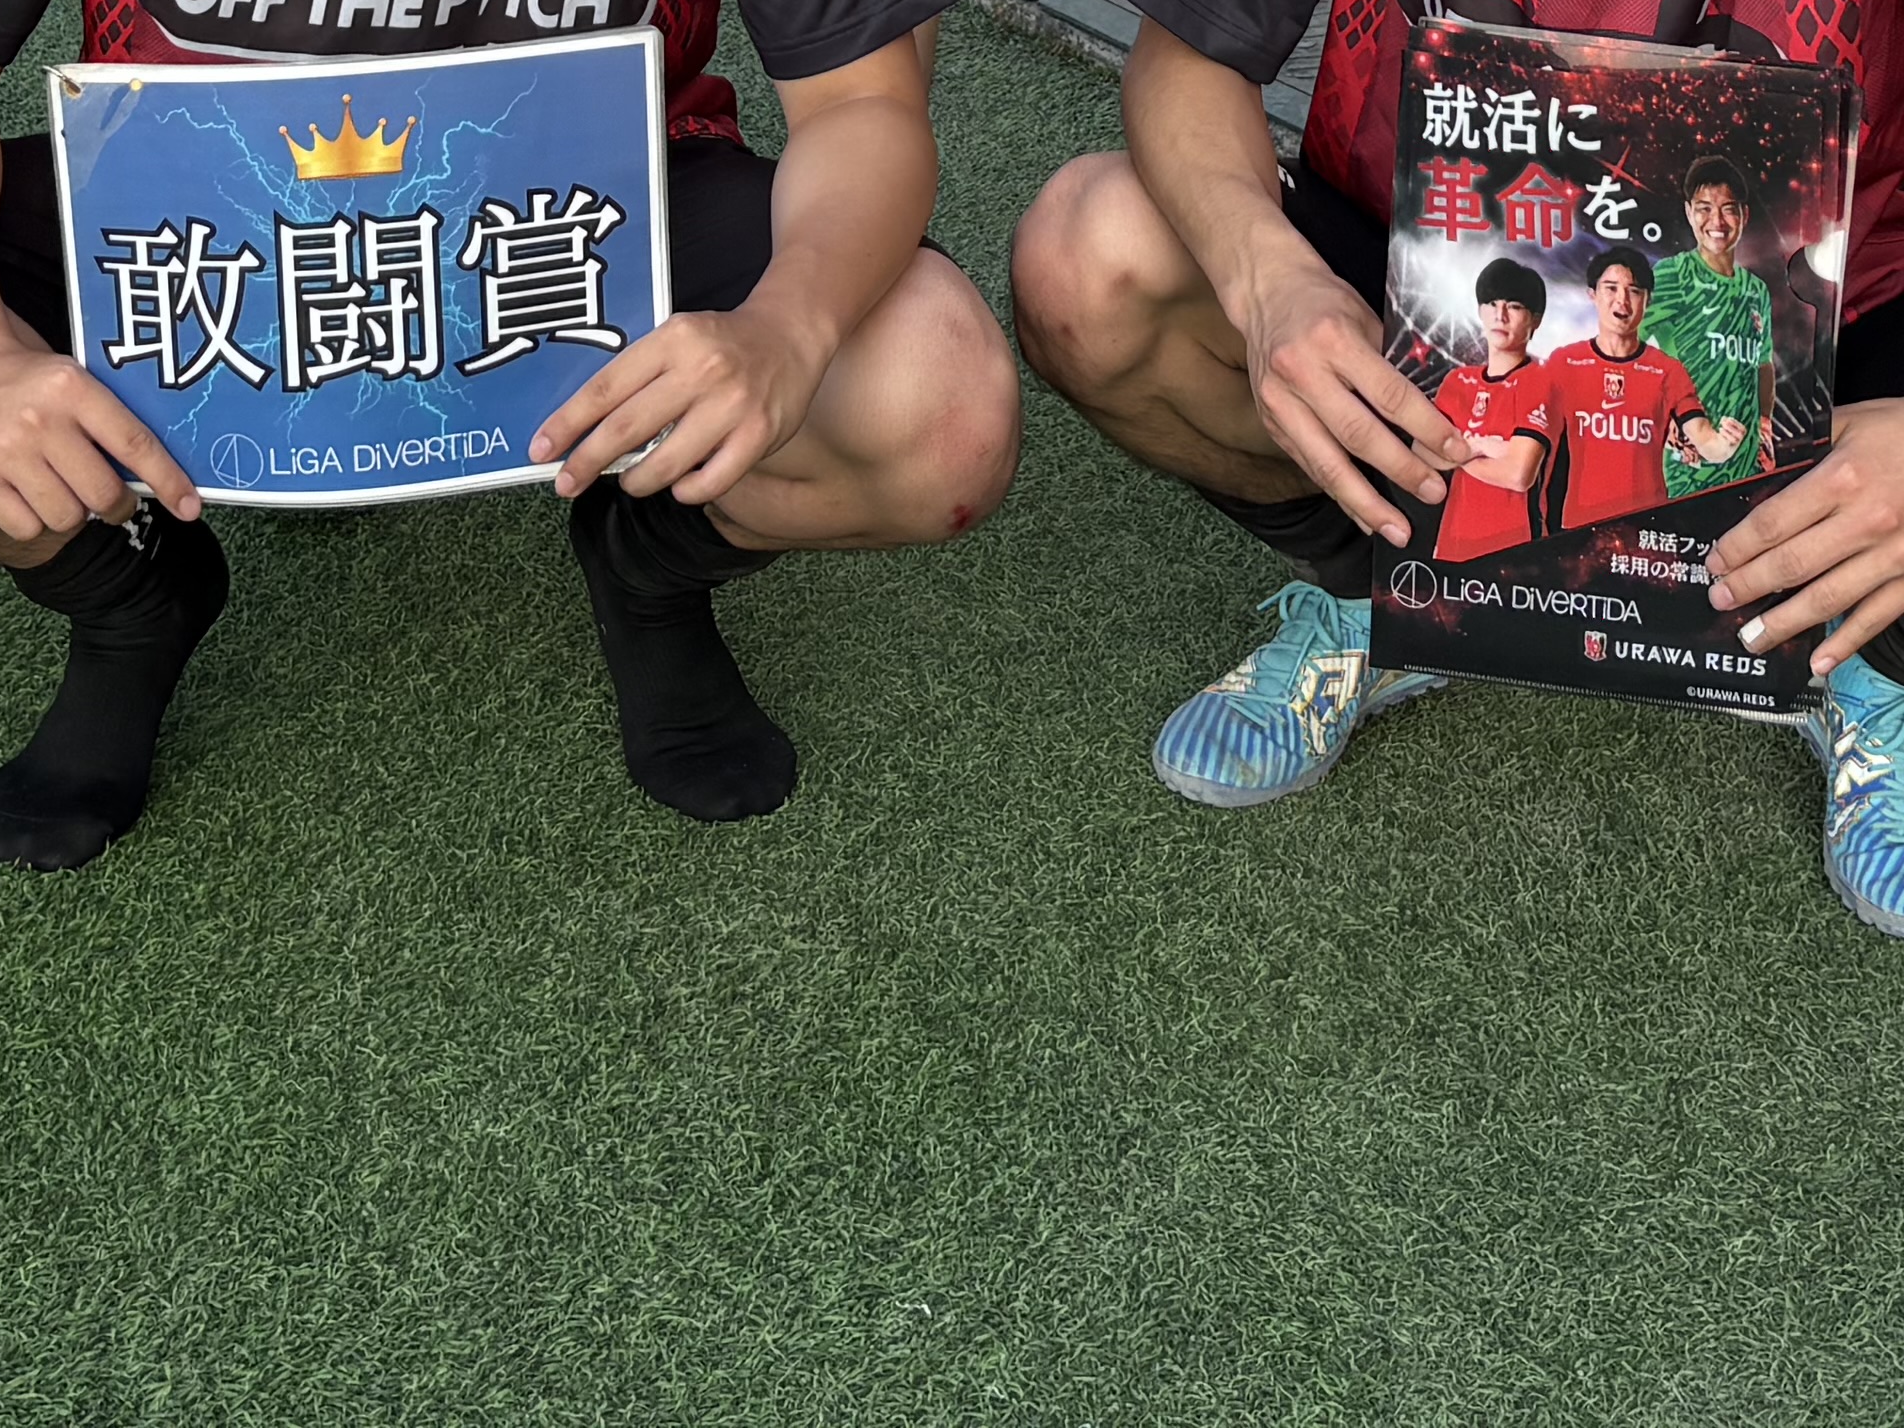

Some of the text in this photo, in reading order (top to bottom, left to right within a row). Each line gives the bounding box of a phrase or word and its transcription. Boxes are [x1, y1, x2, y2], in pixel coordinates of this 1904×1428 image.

[1422, 82, 1602, 154] 就活に
[1415, 155, 1663, 250] 革命を。
[98, 186, 629, 391] 敢闘賞
[1574, 410, 1655, 445] POLUS
[1638, 529, 1718, 557] 就活フッ
[1610, 553, 1722, 586] 採用の常識
[1615, 641, 1768, 676] URAWA REDS
[1742, 692, 1776, 707] REDS
